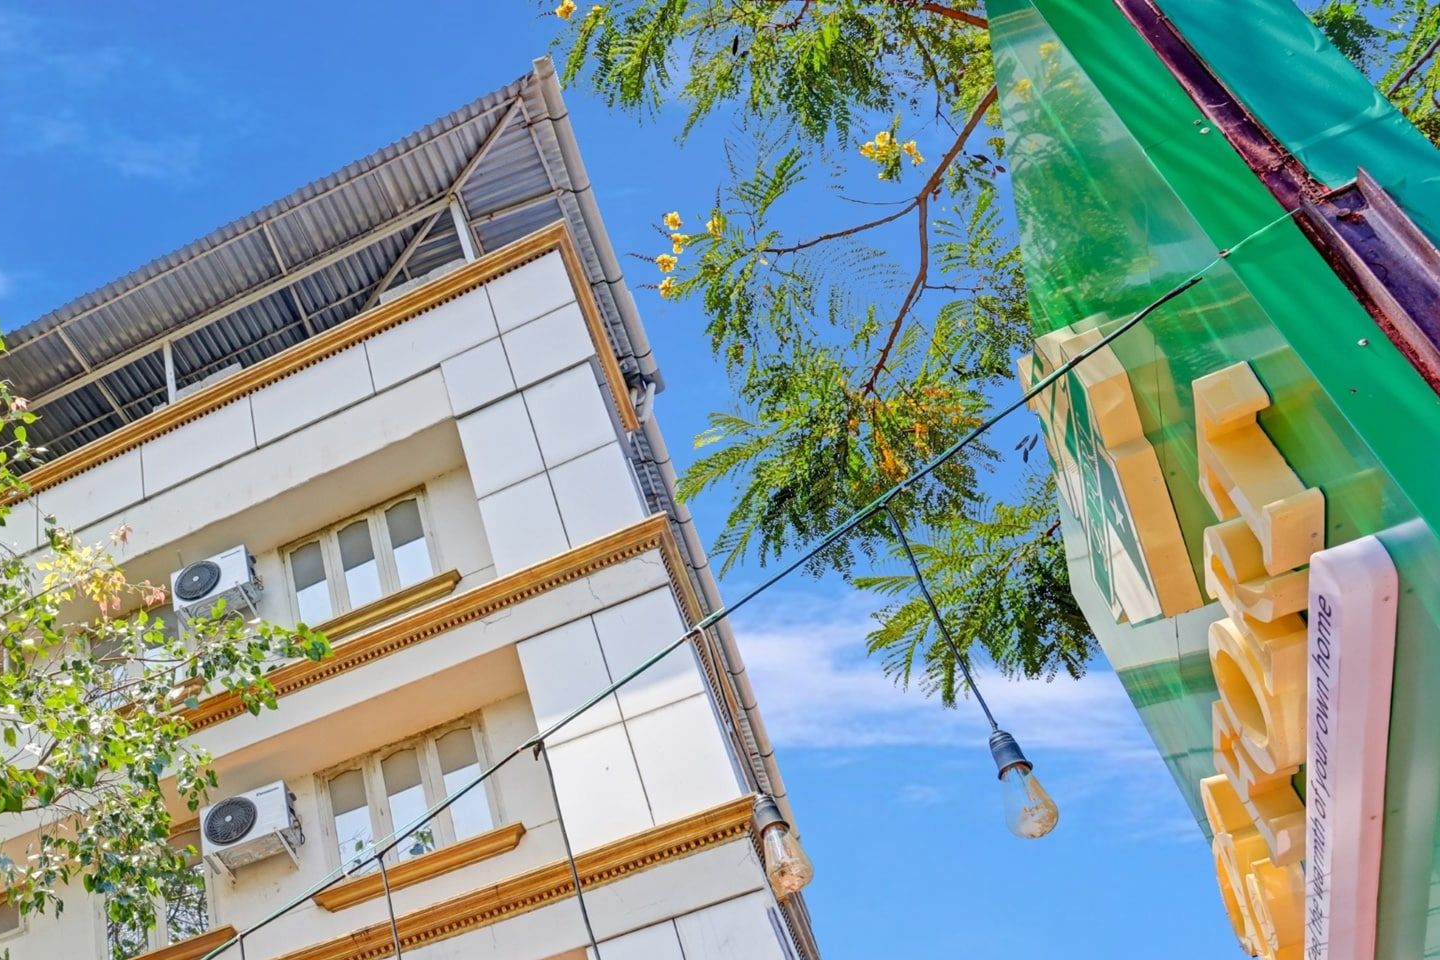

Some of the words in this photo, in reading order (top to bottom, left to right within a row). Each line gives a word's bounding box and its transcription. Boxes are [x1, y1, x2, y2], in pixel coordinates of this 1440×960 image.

[1312, 594, 1332, 678] home
[1316, 676, 1329, 735] own
[1314, 731, 1330, 798] your
[1311, 780, 1326, 819] of
[1310, 815, 1325, 901] warmth
[1309, 898, 1323, 936] the
